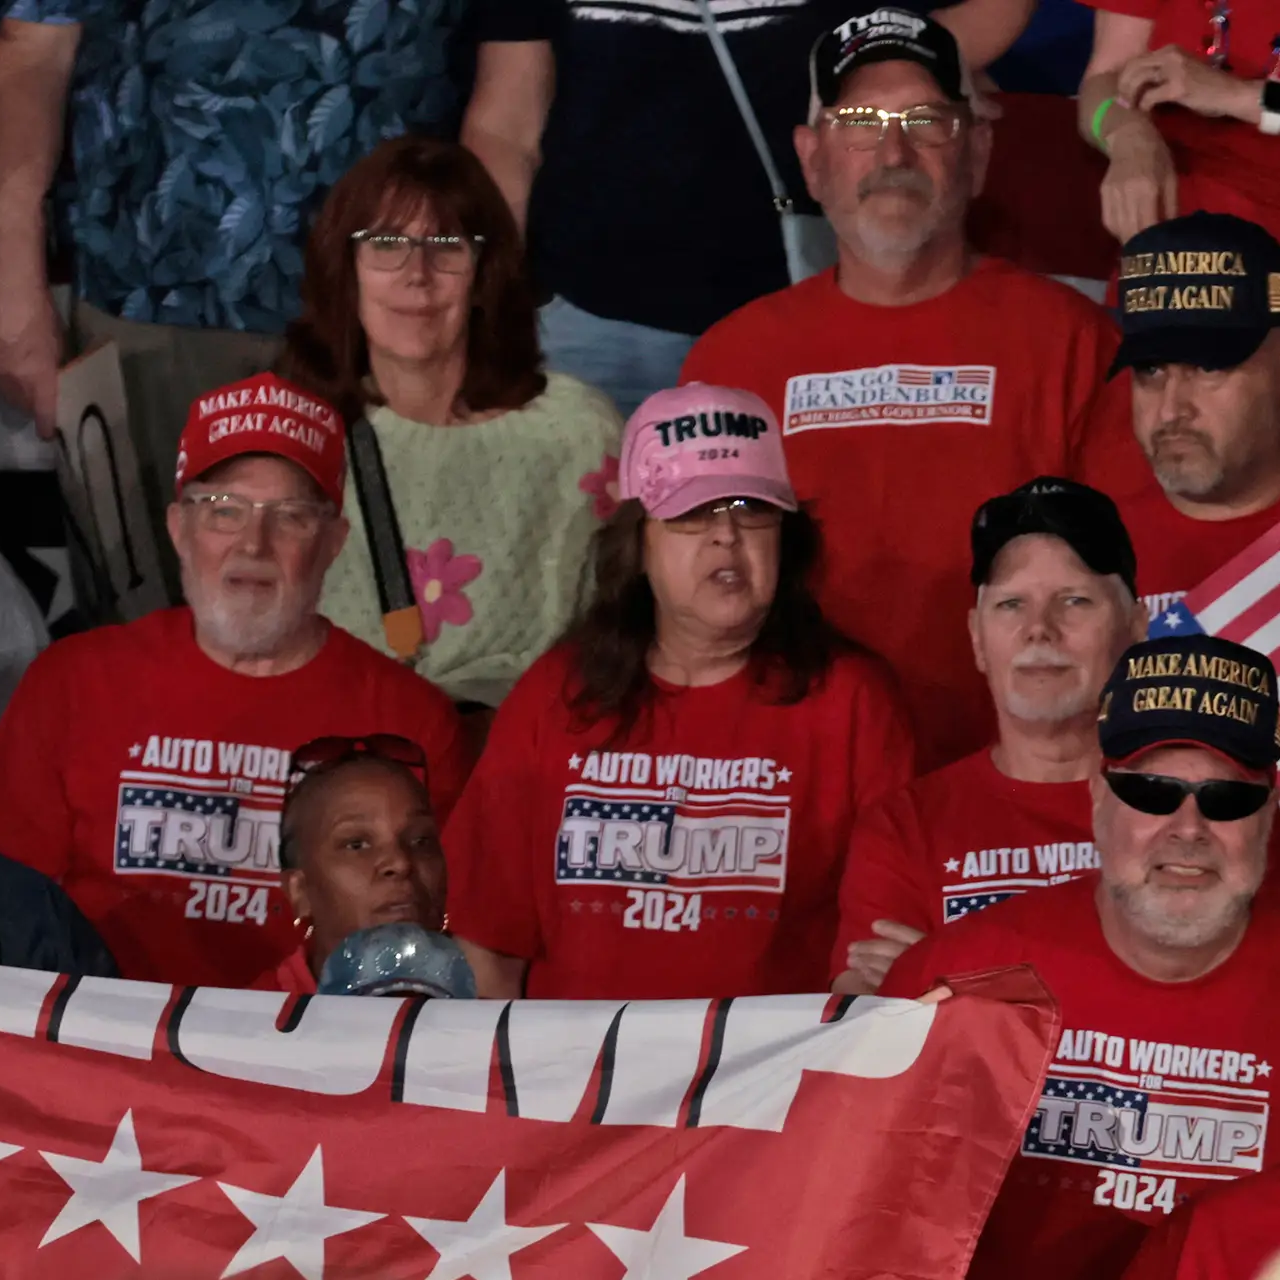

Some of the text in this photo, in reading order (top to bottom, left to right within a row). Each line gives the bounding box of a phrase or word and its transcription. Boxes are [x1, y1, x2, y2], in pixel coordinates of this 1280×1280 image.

[833, 11, 926, 42] Trump
[1154, 252, 1247, 276] AMERICA
[1169, 286, 1235, 310] AGAIN
[789, 386, 987, 412] BRANDENBURG
[791, 369, 894, 395] LET'S GO
[199, 385, 338, 434] MAKE AMERICA
[800, 404, 972, 425] MICHIGAN GOVERNOR
[209, 413, 328, 453] GREAT AGAIN
[654, 411, 768, 447] TRUMP
[697, 449, 740, 461] 2024
[1126, 652, 1271, 697] MAKE AMERICA
[1133, 686, 1197, 712] GREAT
[1198, 691, 1260, 725] AGAIN
[141, 735, 214, 774] AUTO
[581, 751, 777, 789] AUTO WORKERS
[560, 818, 782, 876] TRUMP
[962, 846, 1030, 879] AUTO
[184, 881, 270, 926] 2024
[623, 889, 703, 932] 2024
[1056, 1029, 1258, 1084] AUTO WORKERS
[1138, 1073, 1164, 1091] FOR
[1036, 1099, 1260, 1164] TRUMP
[1093, 1169, 1177, 1215] 2024
